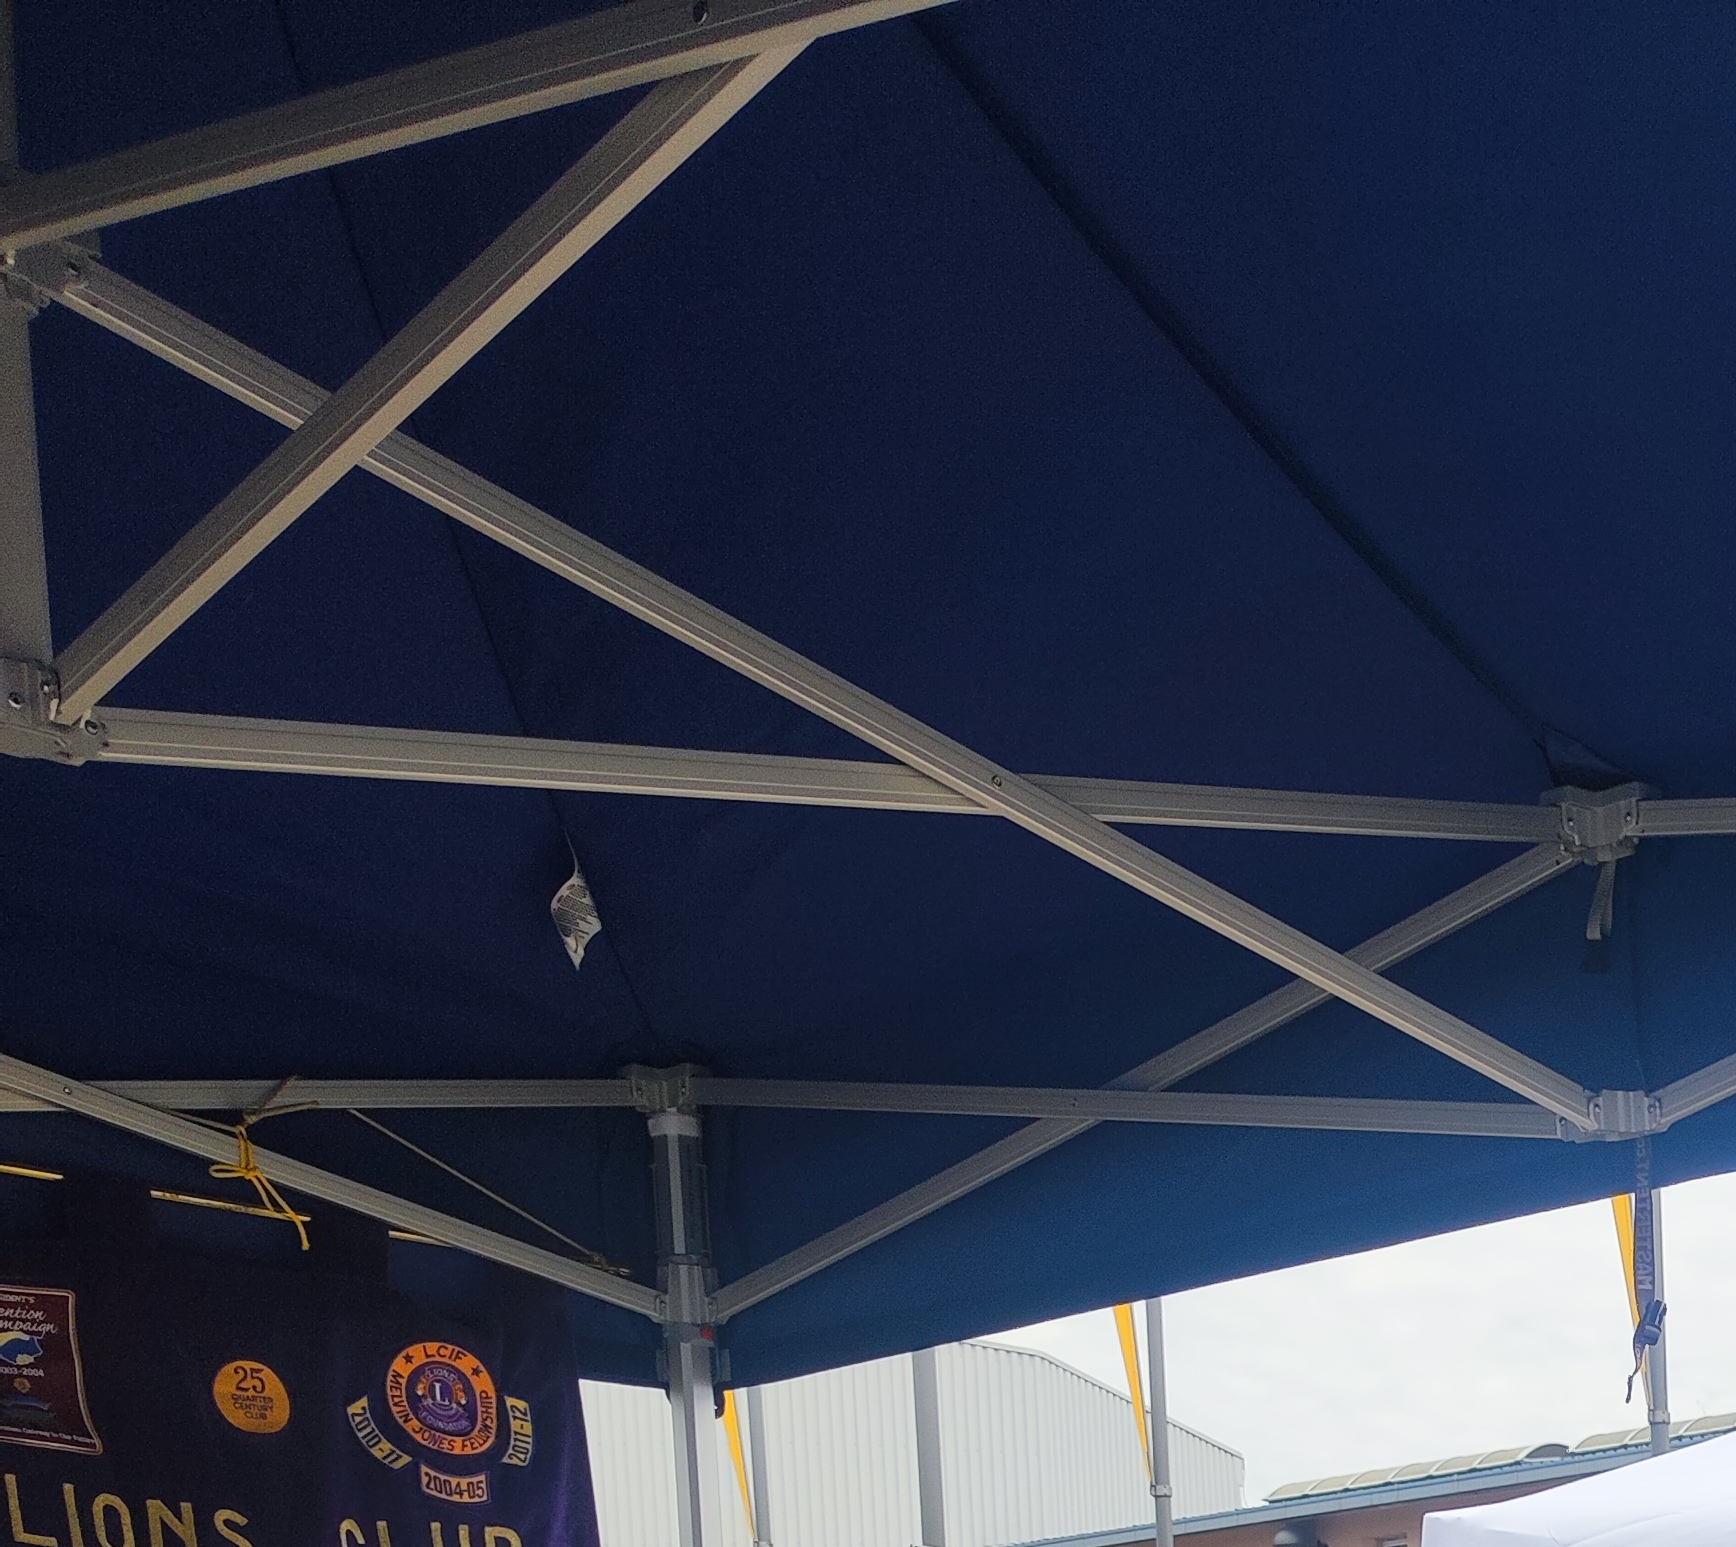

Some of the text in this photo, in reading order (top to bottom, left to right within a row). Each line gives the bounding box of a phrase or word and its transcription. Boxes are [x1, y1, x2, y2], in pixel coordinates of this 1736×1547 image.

[423, 1344, 468, 1363] LCIF
[234, 1366, 266, 1394] 25
[434, 1382, 450, 1404] L
[390, 1369, 493, 1451] MELVIN JONES FELLOWSHIP
[351, 1406, 402, 1465] 2010-11
[507, 1404, 532, 1463] 2011-12
[424, 1472, 485, 1499] 2004-05
